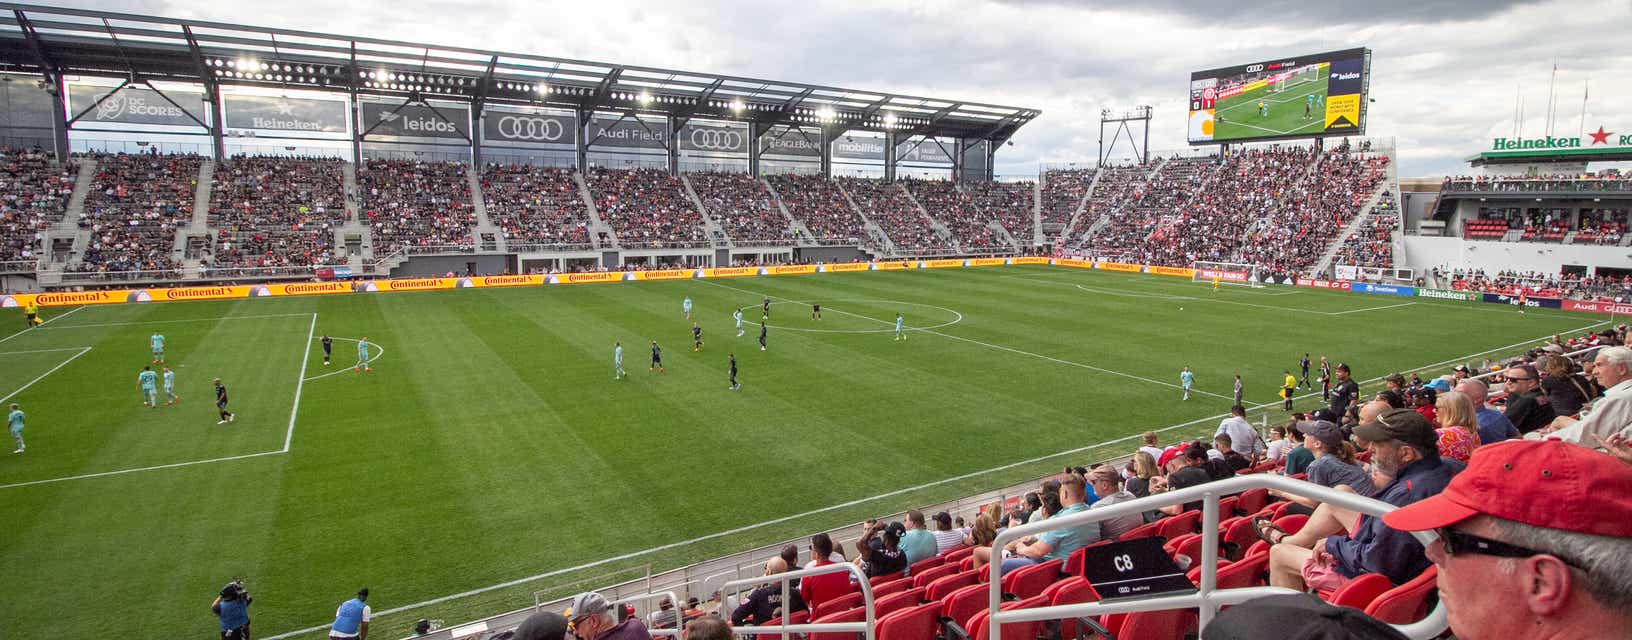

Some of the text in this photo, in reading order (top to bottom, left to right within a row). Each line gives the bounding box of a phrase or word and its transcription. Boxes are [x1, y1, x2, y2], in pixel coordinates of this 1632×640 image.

[1338, 72, 1360, 80] leidos
[129, 105, 183, 117] SCORES
[252, 118, 321, 131] Heineken
[403, 115, 456, 132] leidos
[596, 127, 663, 141] Audi Field
[1493, 136, 1581, 150] Heineken
[484, 277, 526, 286] Continental
[568, 274, 607, 282] Continental
[284, 283, 337, 294] Continental
[390, 280, 437, 289] Continental
[35, 293, 100, 305] Continental
[166, 287, 225, 299] Continental
[1418, 288, 1466, 300] Heineken
[1114, 554, 1134, 572] C8
